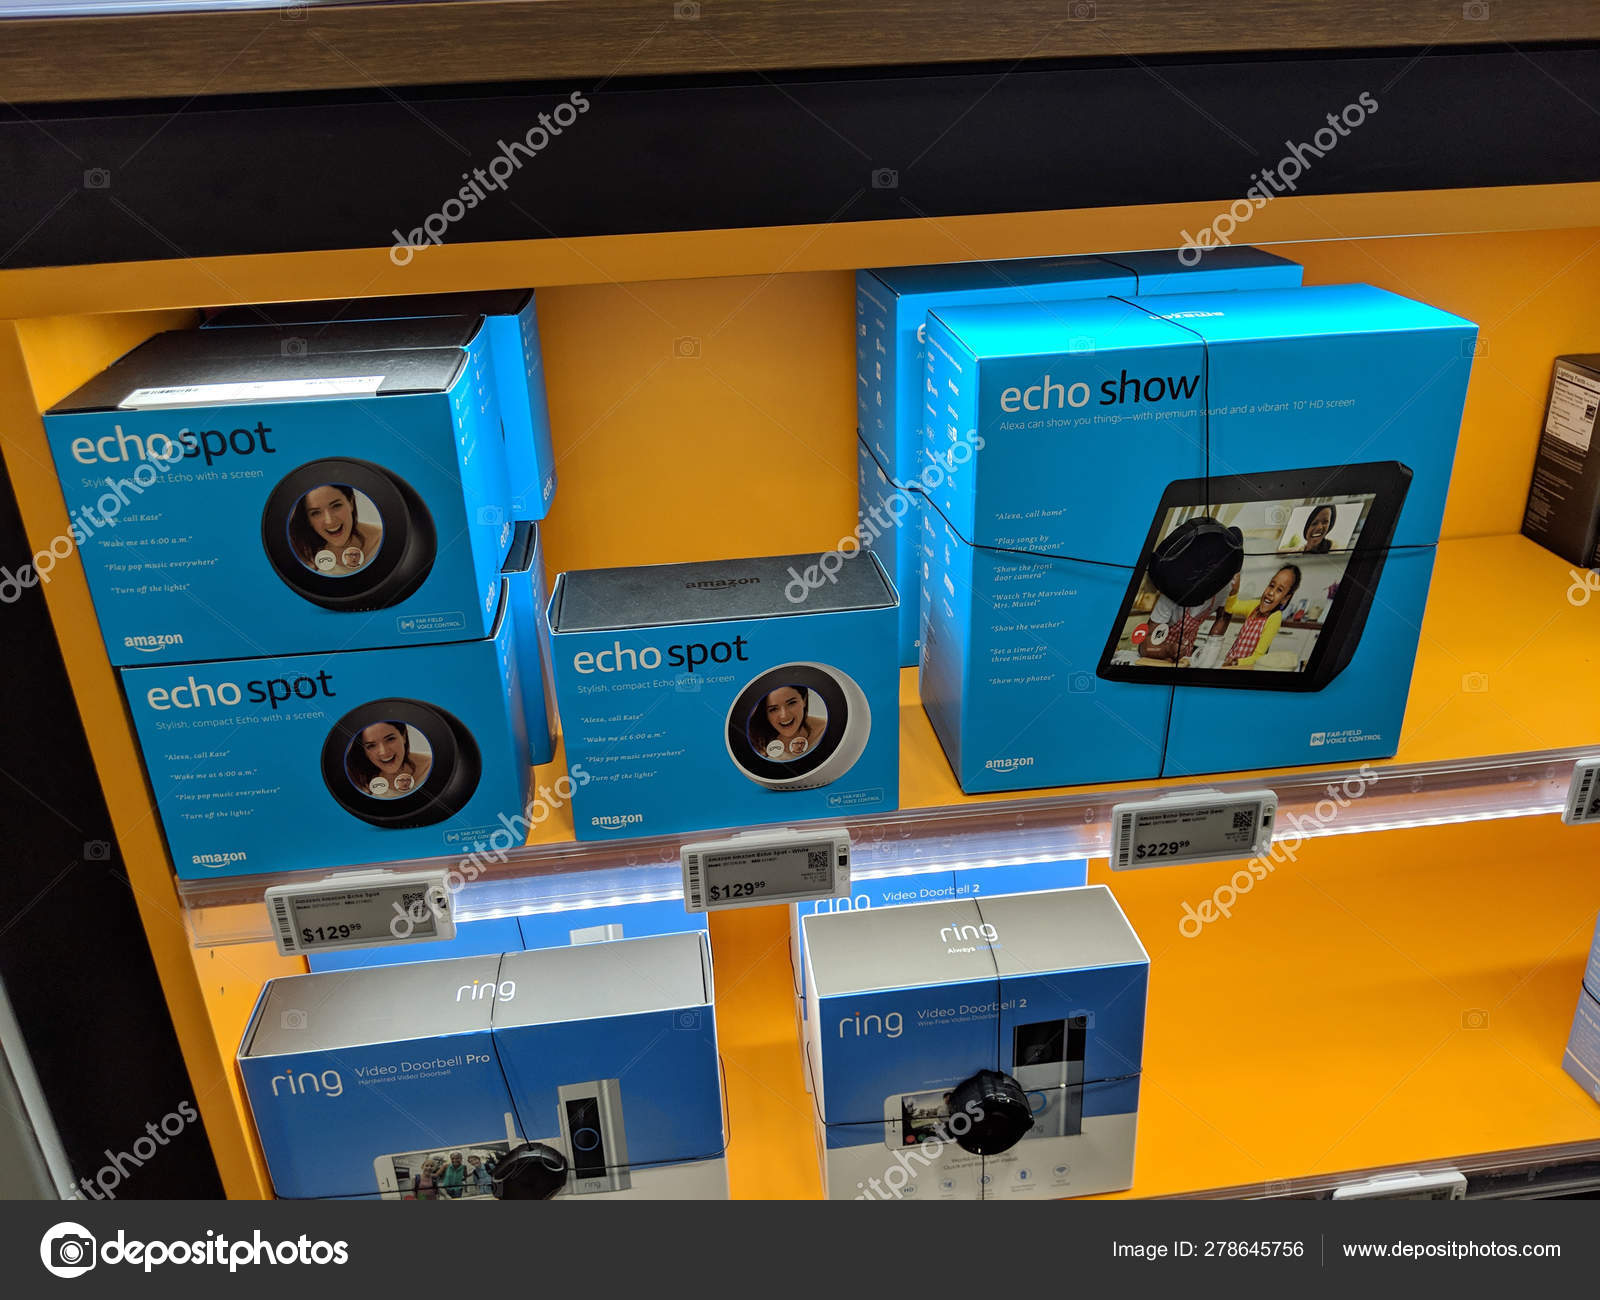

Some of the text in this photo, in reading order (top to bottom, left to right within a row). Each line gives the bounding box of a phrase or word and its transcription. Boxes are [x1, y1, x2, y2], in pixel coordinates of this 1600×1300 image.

[1000, 370, 1200, 413] echo show
[1000, 421, 1025, 431] Alexa
[1027, 420, 1044, 429] can
[1046, 418, 1071, 427] show
[1073, 418, 1091, 427] you
[1155, 409, 1197, 420] premium
[1230, 404, 1247, 415] and
[1258, 403, 1288, 413] vibrant
[1309, 400, 1323, 409] HD
[1326, 399, 1355, 408] screen
[71, 421, 277, 466] echo spot
[167, 474, 193, 483] Echo
[196, 471, 219, 481] with
[231, 469, 264, 479] screen
[1025, 509, 1040, 518] call
[139, 539, 149, 547] at
[150, 537, 169, 546] 6:00
[128, 562, 144, 571] pop
[144, 561, 168, 569] music
[1032, 563, 1053, 572] front
[137, 585, 148, 594] off
[149, 585, 162, 593] the
[685, 576, 761, 590] amazon
[1038, 588, 1077, 598] Marvelous
[124, 633, 184, 650] amazon
[573, 635, 749, 674] echo spot
[1035, 645, 1047, 654] for
[147, 670, 336, 710] echo spot
[577, 684, 609, 695] Stylish,
[612, 680, 651, 692] compact
[653, 679, 675, 688] Echo
[676, 677, 697, 687] with
[707, 674, 735, 684] screen
[156, 720, 190, 731] Stylish,
[192, 718, 234, 729] compact
[236, 715, 260, 725] Echo
[261, 714, 283, 723] with
[294, 711, 325, 720] screen
[608, 714, 622, 722] call
[1326, 734, 1381, 744] VOICE CONTROL
[193, 751, 208, 759] call
[605, 755, 619, 763] pop
[620, 753, 640, 761] music
[985, 757, 1034, 772] amazon
[610, 774, 620, 782] off
[197, 792, 212, 801] pop
[212, 791, 234, 799] music
[204, 811, 215, 821] off
[592, 813, 643, 829] amazon
[192, 851, 247, 868] amazon
[883, 891, 916, 901] Video
[973, 884, 980, 892] 2
[940, 922, 998, 943] ring
[948, 946, 976, 954] Always
[456, 979, 516, 1002] ring
[839, 1011, 903, 1038] ring
[917, 1007, 956, 1019] Video
[1019, 999, 1027, 1008] 2
[272, 1054, 490, 1098] ring Video Doorbell Pro
[420, 1069, 451, 1078] Doorbell
